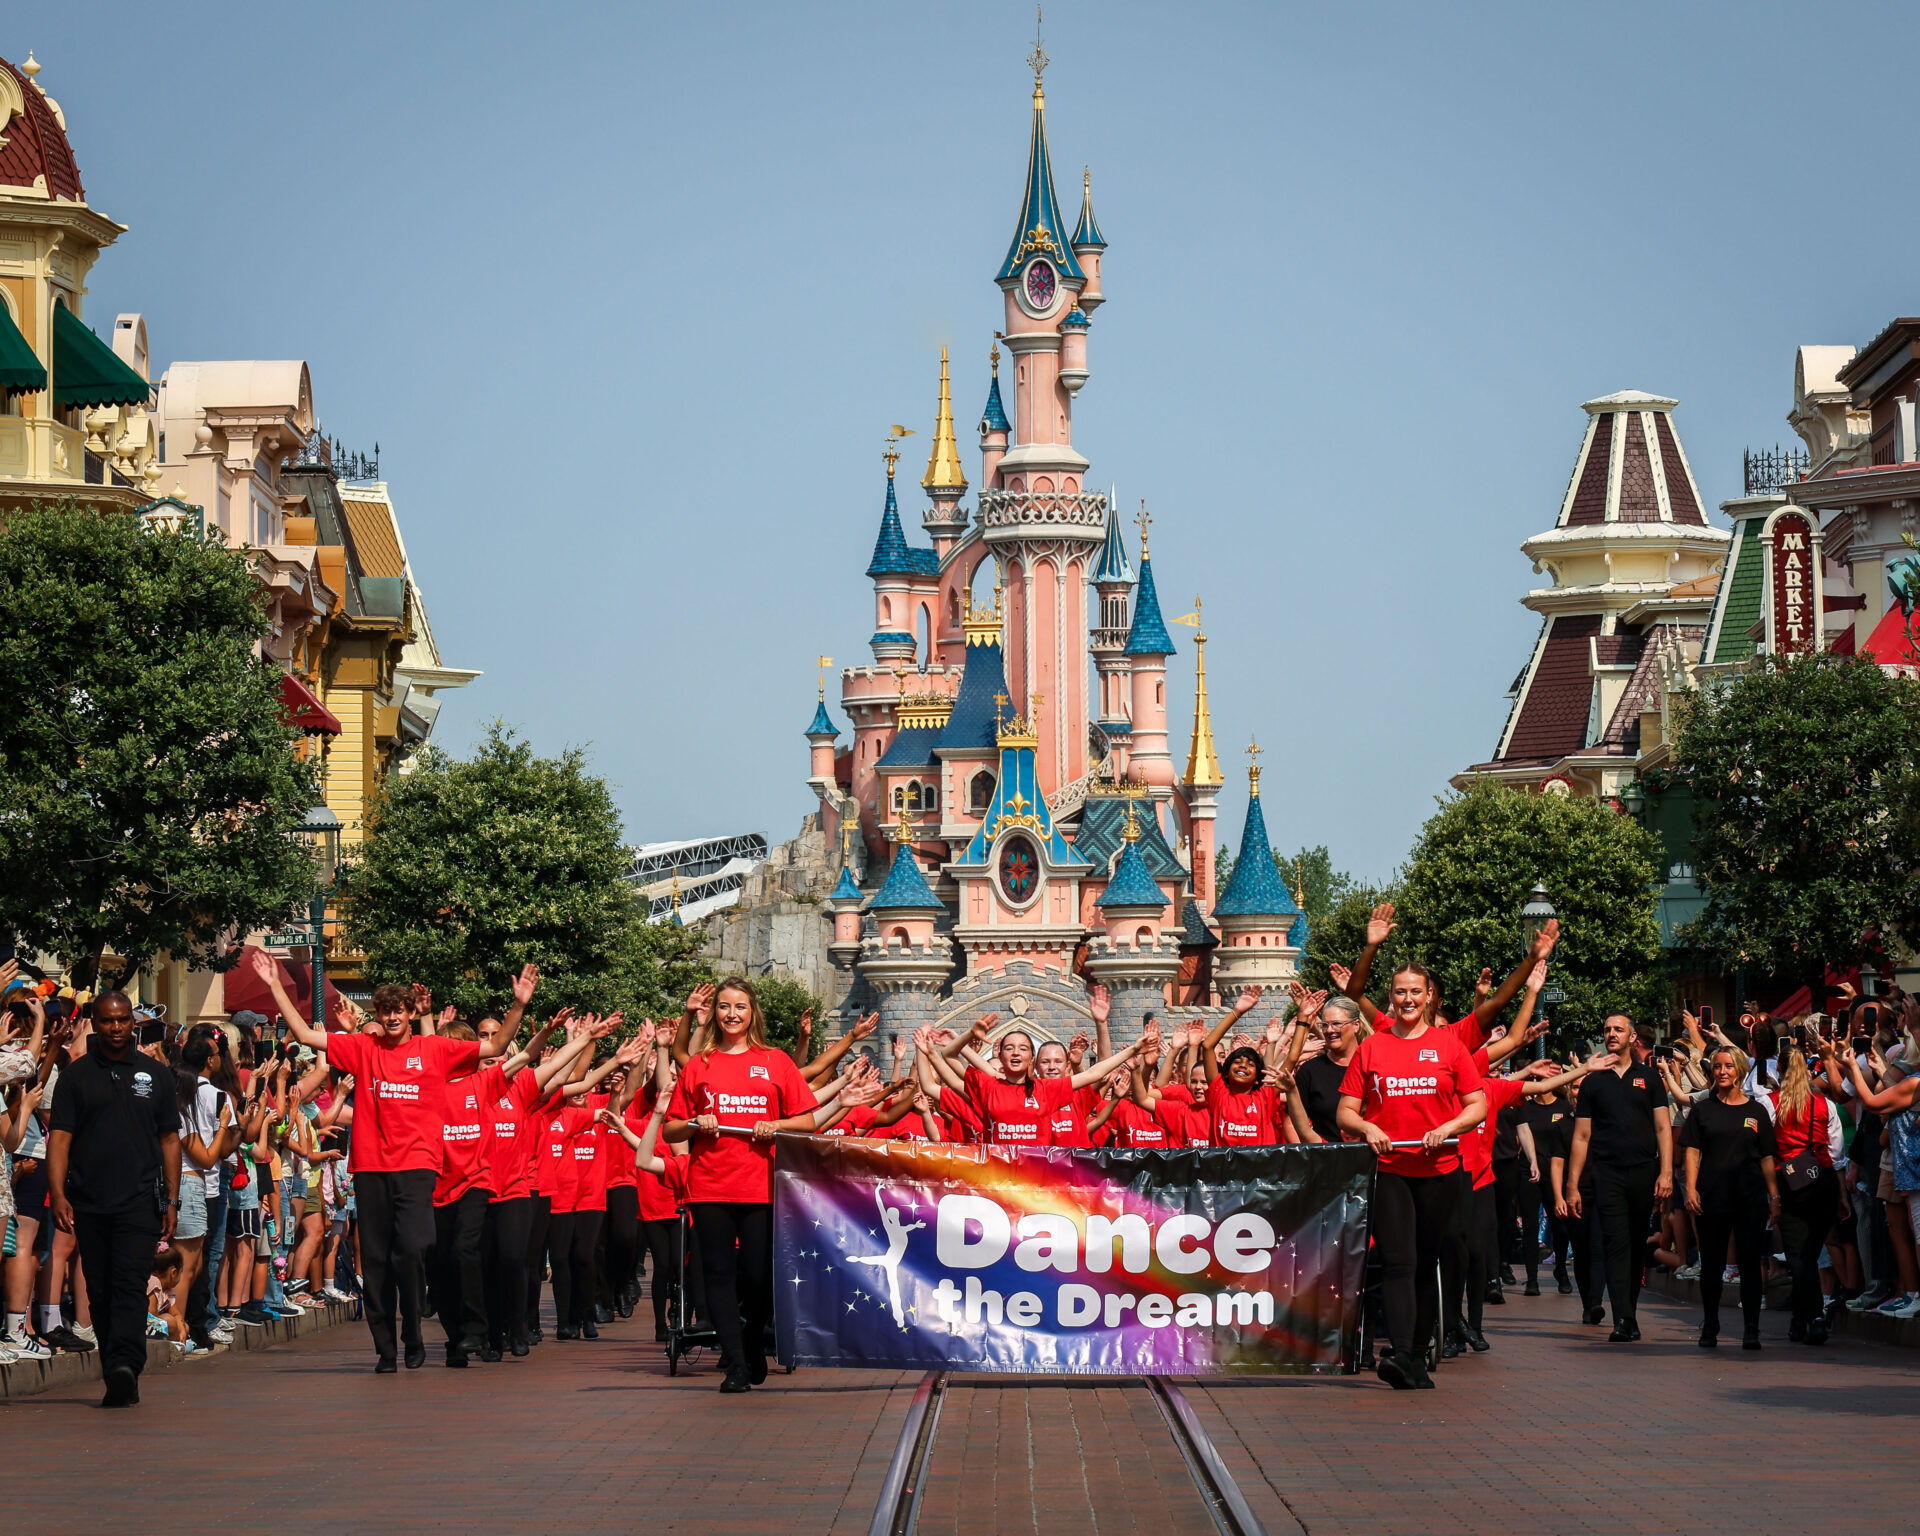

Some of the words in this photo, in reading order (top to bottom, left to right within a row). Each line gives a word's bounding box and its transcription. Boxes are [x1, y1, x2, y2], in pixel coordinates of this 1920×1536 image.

[1781, 533, 1805, 641] MARKET
[346, 992, 372, 1000] OTHING
[380, 1080, 419, 1093] Dance
[1385, 1076, 1437, 1088] Dance
[393, 1092, 419, 1100] Dream
[1386, 1088, 1403, 1096] the
[718, 1093, 768, 1106] Dance
[719, 1105, 735, 1113] the
[736, 1106, 767, 1114] Dream
[443, 1124, 480, 1134] Dance
[495, 1122, 515, 1131] nce
[997, 1122, 1037, 1133] Dance
[1227, 1122, 1257, 1132] Dance
[443, 1133, 455, 1141] the
[1012, 1132, 1037, 1140] Dream
[1136, 1129, 1162, 1137] Dance
[936, 1193, 1276, 1275] Dance
[932, 1276, 1044, 1326] the
[1056, 1284, 1275, 1329] Dream
